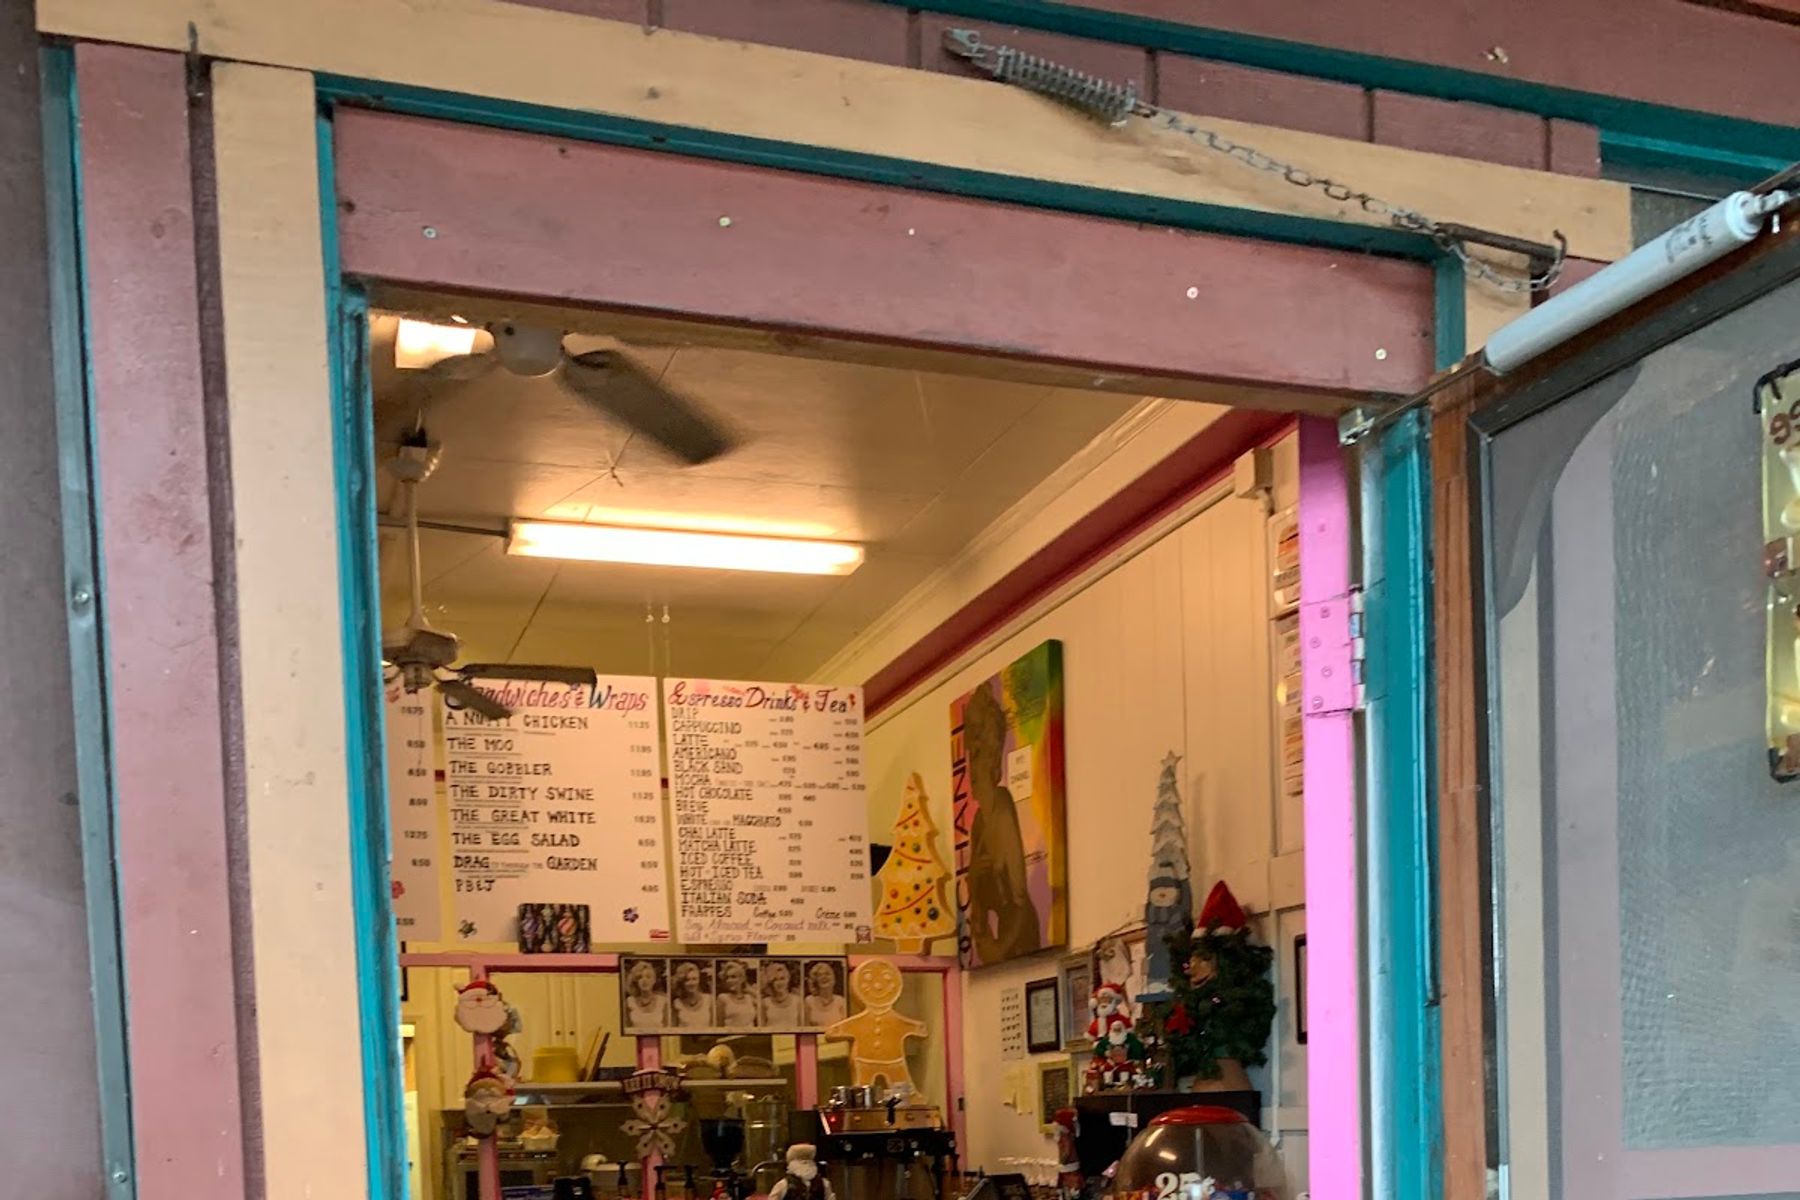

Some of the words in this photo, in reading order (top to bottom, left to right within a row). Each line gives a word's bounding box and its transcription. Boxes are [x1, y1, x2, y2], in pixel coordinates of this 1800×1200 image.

[590, 685, 649, 718] Wraps
[668, 681, 742, 707] Espresso
[745, 687, 796, 711] Drinks
[815, 688, 847, 713] Tea
[446, 712, 458, 725] A
[523, 714, 589, 730] CHICKEN
[673, 720, 742, 735] CAPPUCCINO
[447, 738, 476, 750] THE
[484, 739, 514, 752] MOO
[673, 733, 709, 747] LATTE
[672, 747, 737, 761] AMERICANO
[449, 761, 478, 774] THE
[487, 762, 553, 776] GOBBLER
[674, 760, 710, 773] BLACK
[714, 760, 743, 775] SAND
[675, 773, 711, 786] MOCHA
[450, 785, 480, 798] THE
[488, 786, 538, 800] DIRTY
[546, 787, 595, 801] SWINE
[675, 786, 695, 799] HOT
[699, 787, 753, 801] CHOCOLATE
[676, 799, 709, 813] BREVE
[451, 809, 480, 822] THE
[491, 810, 540, 824] GREAT
[547, 811, 597, 825] WHITE
[451, 832, 481, 845] THE
[491, 833, 520, 846] EGG
[531, 834, 580, 848] SALAD
[678, 826, 702, 839] CHAI
[707, 827, 737, 840] LATTE
[678, 839, 721, 852] MATCHA
[724, 840, 758, 854] LATTE
[453, 856, 490, 869] DRAG
[546, 856, 598, 871] GARDEN
[680, 851, 708, 865] ICED
[712, 852, 754, 867] COFFEE
[680, 865, 704, 878] HOT
[712, 865, 740, 879] ICED
[742, 865, 763, 880] TEA
[681, 879, 733, 891] ESPRESSO
[681, 892, 732, 905] ITALIAN
[736, 891, 768, 905] SODA
[681, 905, 732, 918] FRAPPES
